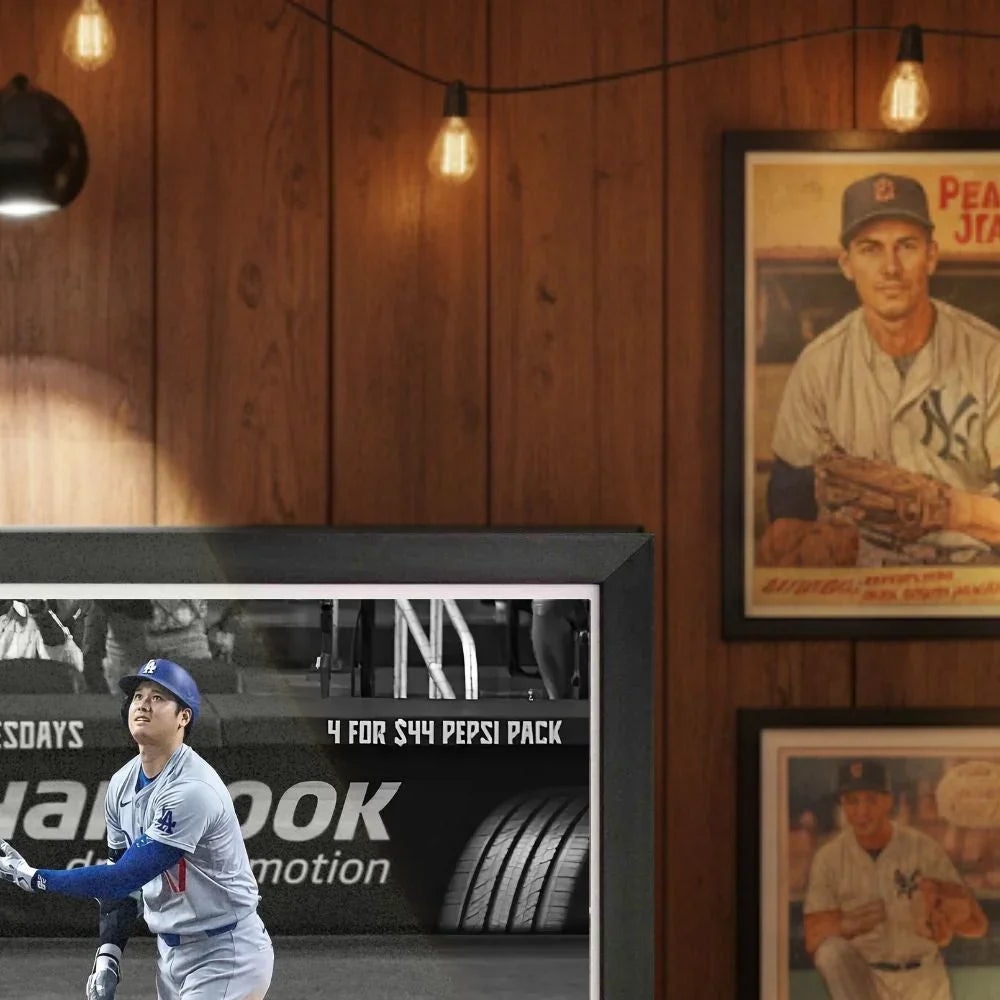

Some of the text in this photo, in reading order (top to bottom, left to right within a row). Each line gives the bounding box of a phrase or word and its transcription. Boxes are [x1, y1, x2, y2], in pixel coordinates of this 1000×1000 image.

[327, 718, 562, 747] 4 FOR $44 PEPSI PACK
